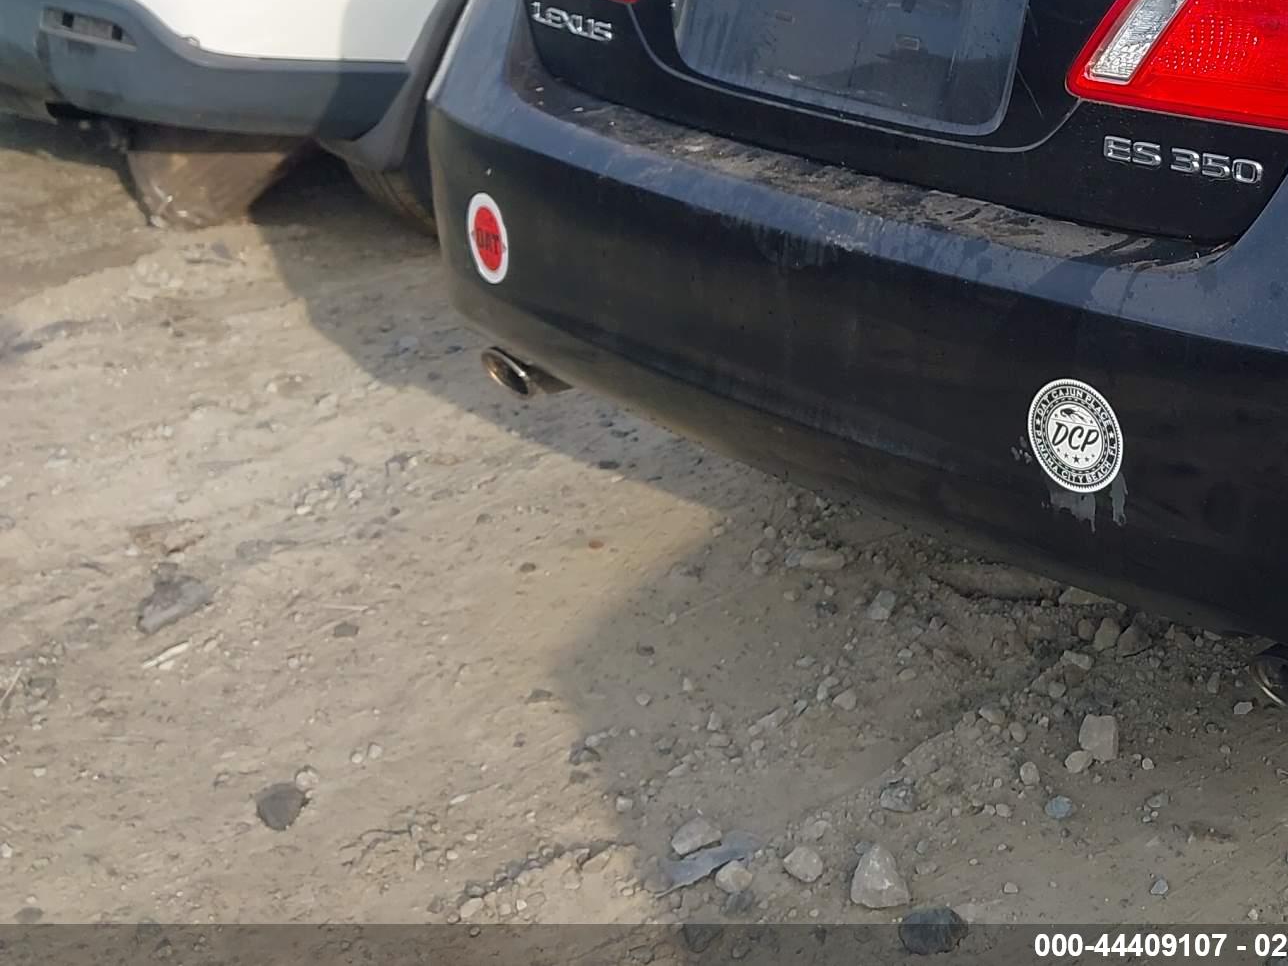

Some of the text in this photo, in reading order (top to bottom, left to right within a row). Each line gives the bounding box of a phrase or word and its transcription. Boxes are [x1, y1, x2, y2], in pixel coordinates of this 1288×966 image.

[531, 1, 612, 42] LEXUS
[1103, 135, 1264, 184] ES 350
[1037, 387, 1112, 425] DAT CAJUN PLACE
[1035, 430, 1063, 475] PANAMA
[1062, 471, 1084, 483] CITY
[1086, 460, 1112, 483] BEACH
[1052, 422, 1099, 452] DCP
